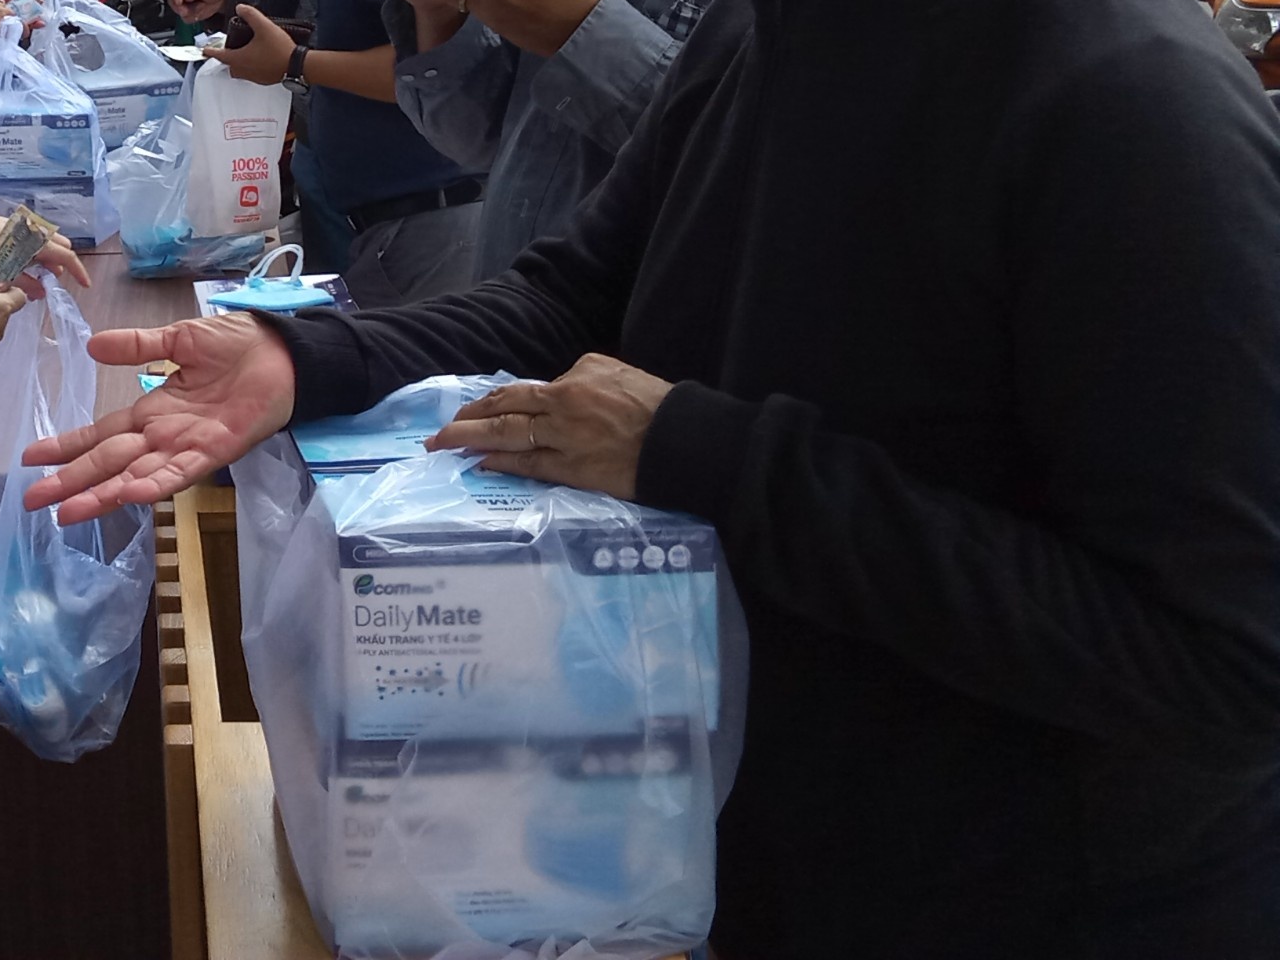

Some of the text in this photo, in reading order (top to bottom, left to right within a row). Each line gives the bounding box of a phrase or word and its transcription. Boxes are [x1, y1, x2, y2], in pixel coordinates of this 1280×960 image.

[231, 157, 269, 172] 100%
[231, 171, 269, 181] PASSION
[354, 604, 483, 633] DailyMate
[388, 634, 425, 645] TRANG
